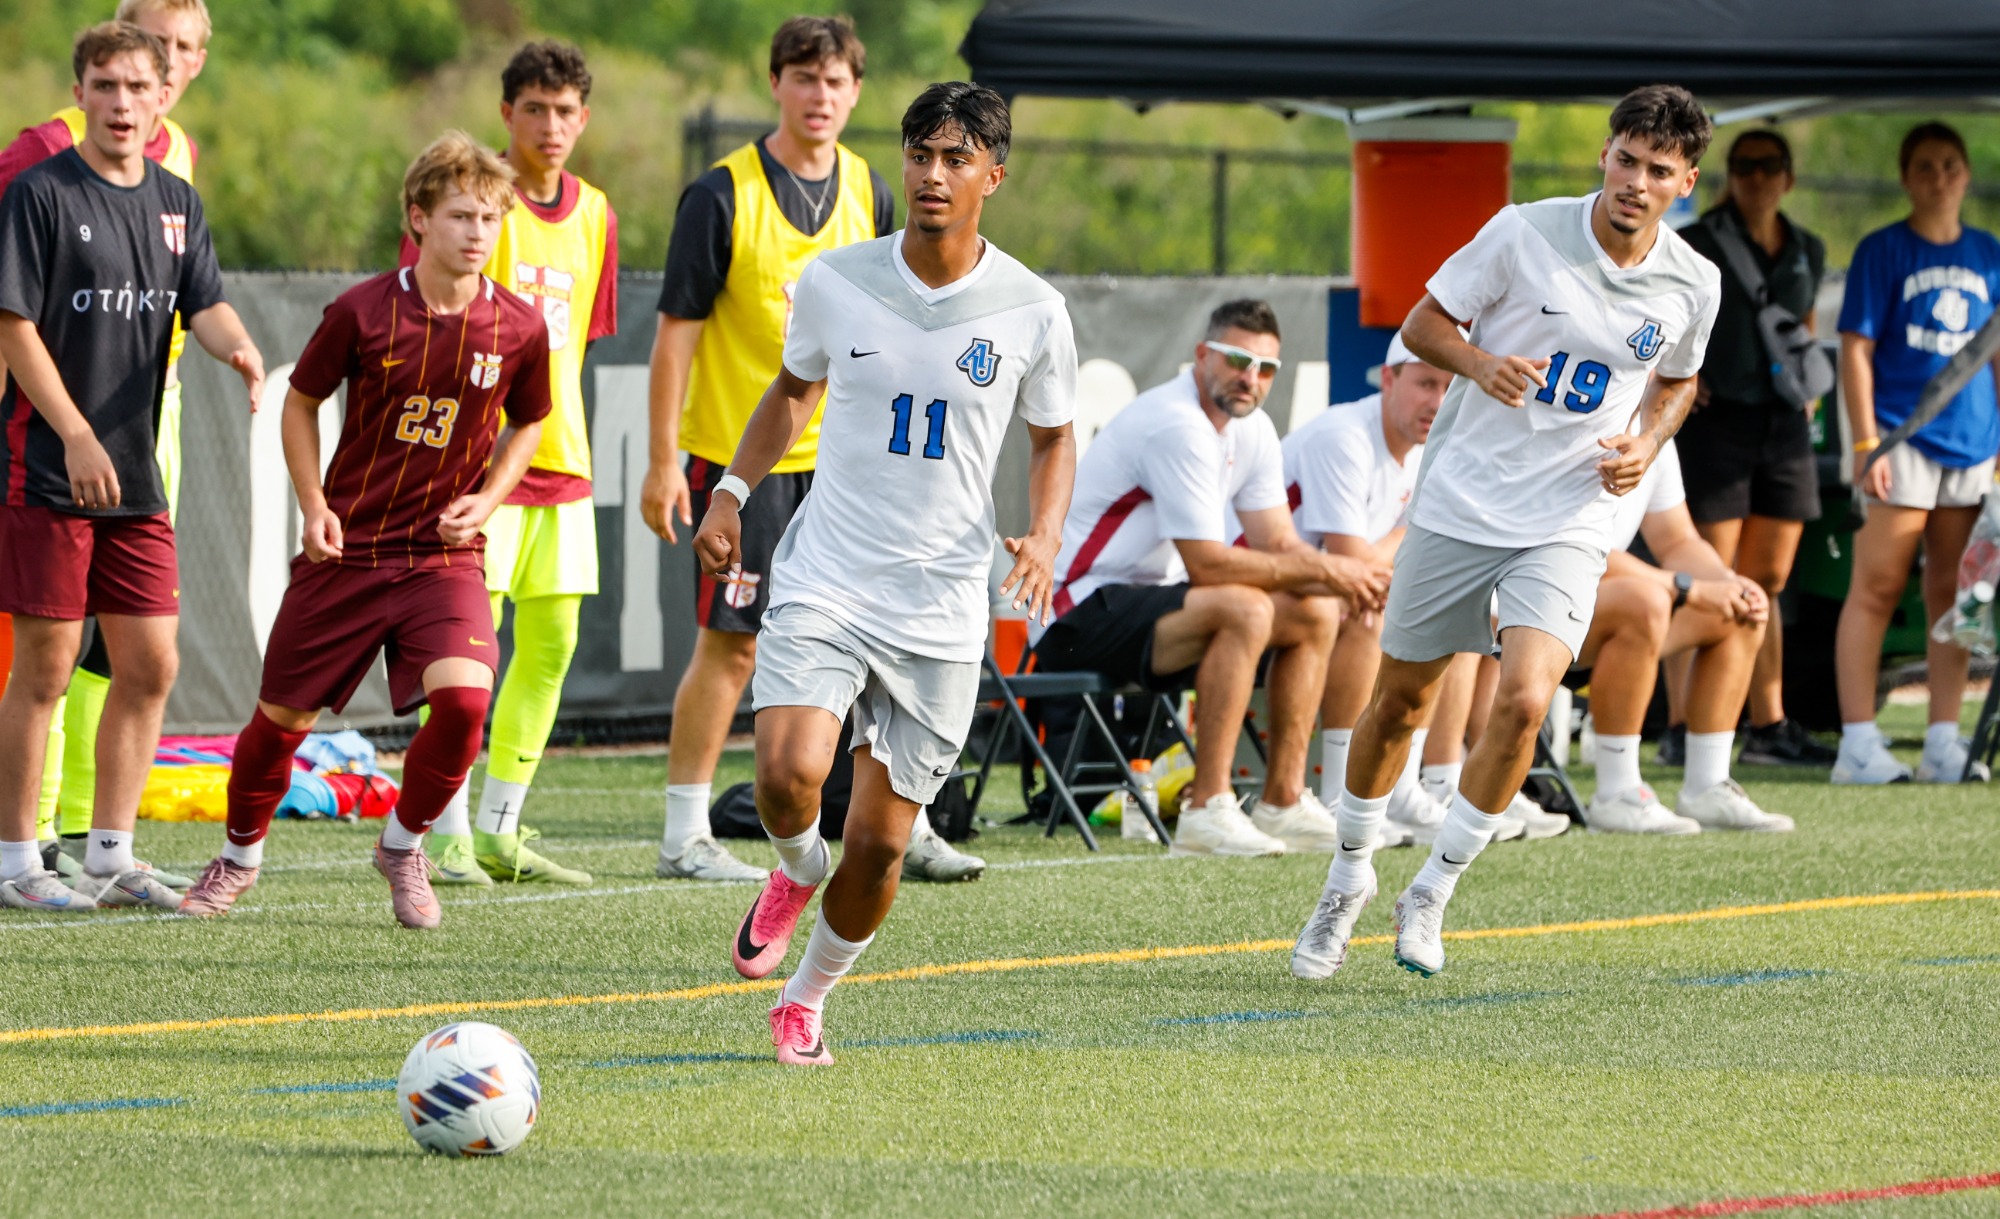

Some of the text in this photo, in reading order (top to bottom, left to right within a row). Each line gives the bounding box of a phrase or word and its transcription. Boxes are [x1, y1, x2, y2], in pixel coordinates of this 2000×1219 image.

[79, 224, 92, 242] 9
[72, 280, 178, 320] στήκτ
[1903, 265, 1989, 304] AURORA
[1535, 350, 1611, 414] 19
[396, 395, 460, 449] 23
[888, 393, 948, 460] 11
